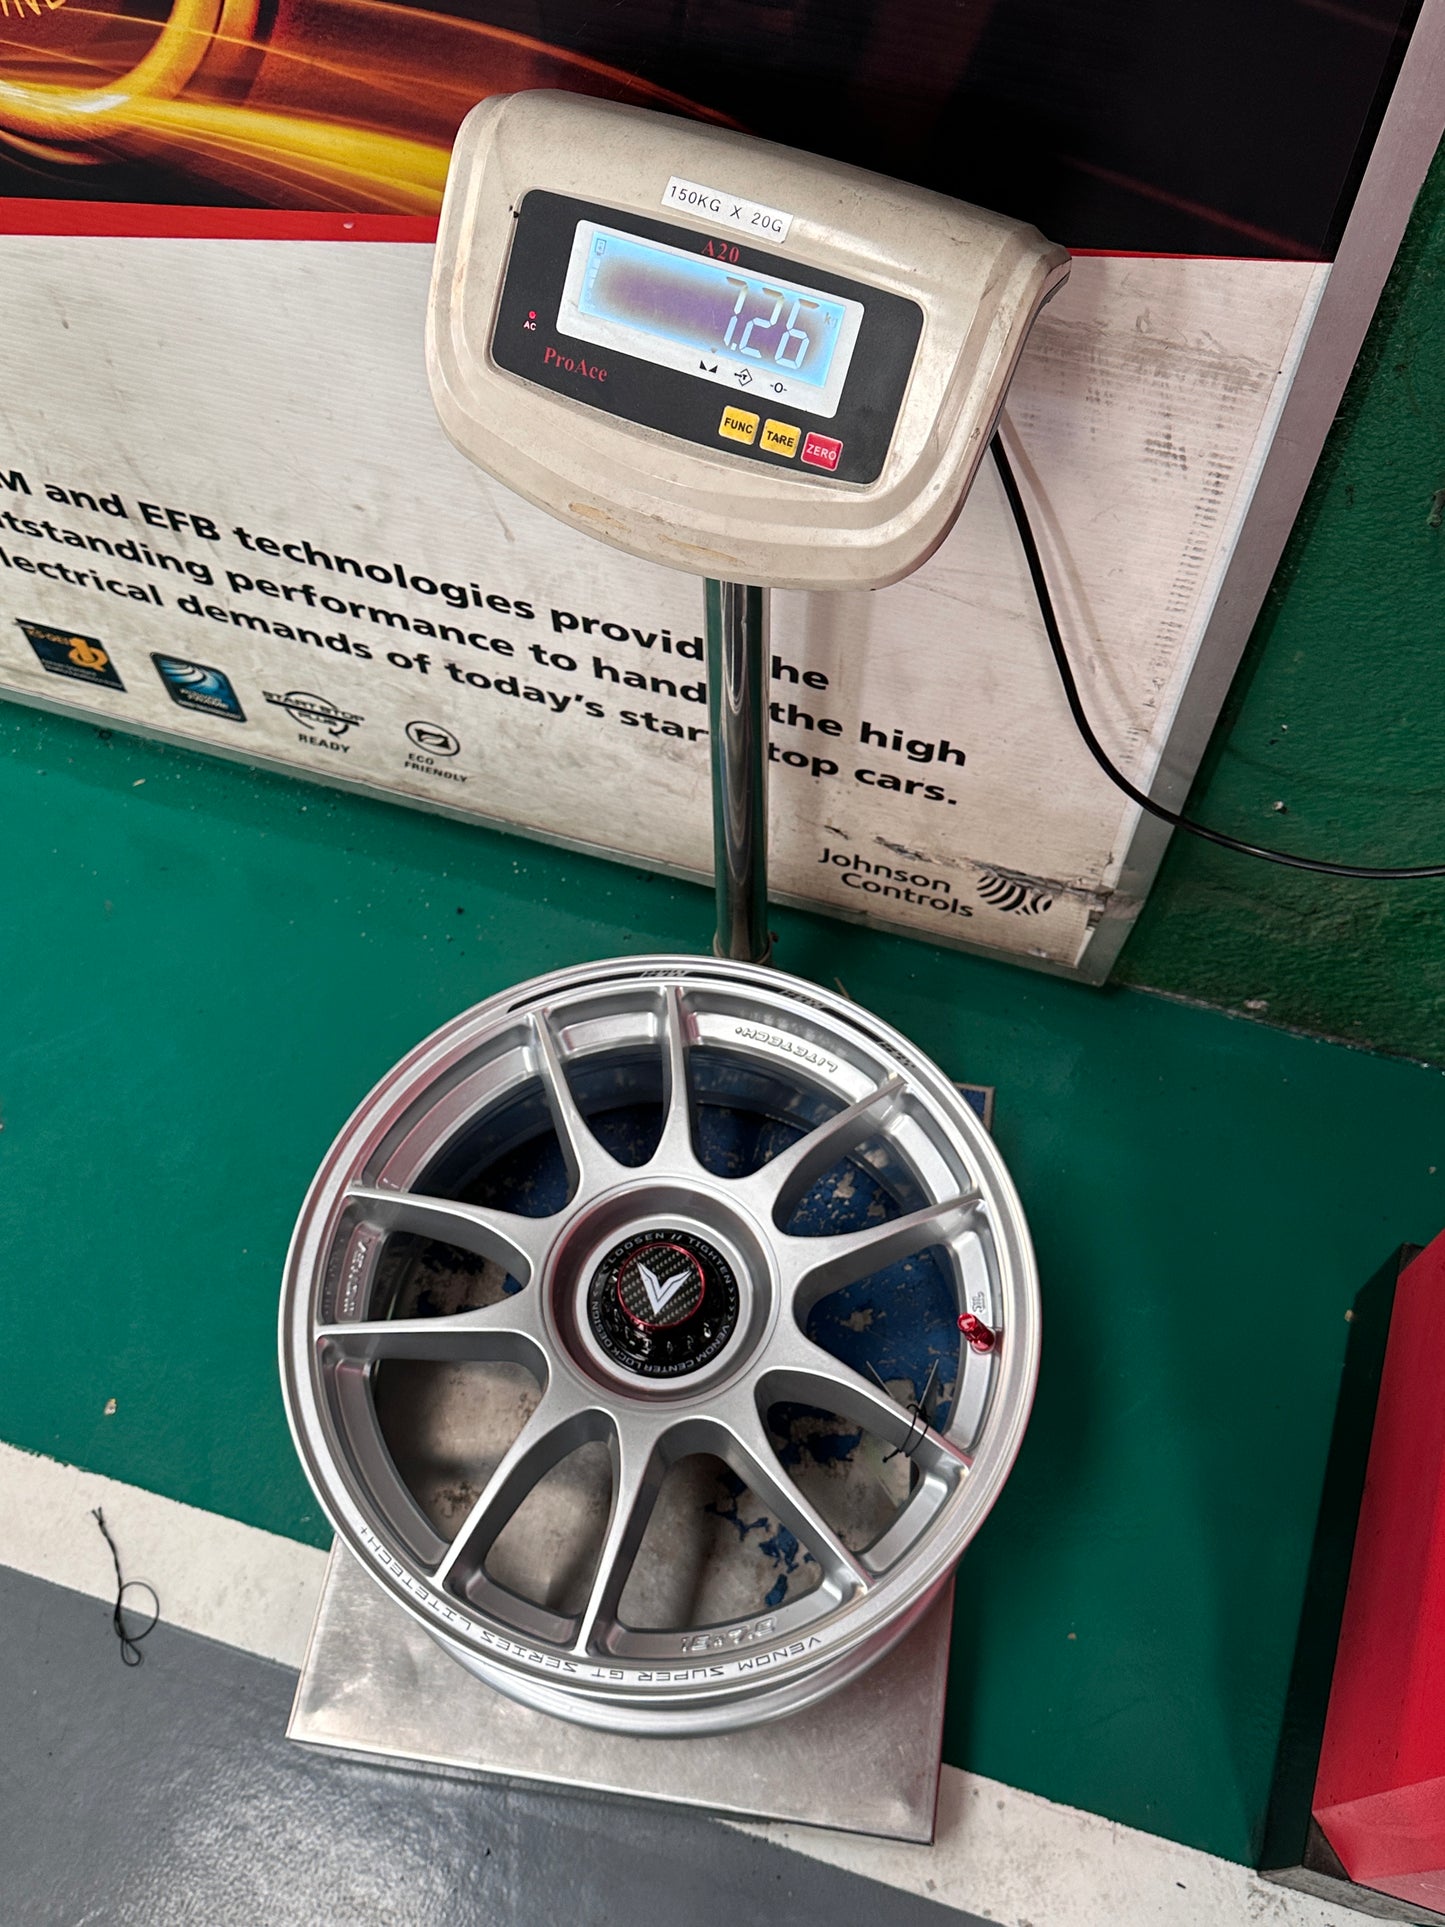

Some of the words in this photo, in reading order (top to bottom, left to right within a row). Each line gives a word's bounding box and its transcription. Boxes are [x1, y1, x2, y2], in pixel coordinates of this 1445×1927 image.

[671, 186, 721, 212] 150KG
[730, 205, 742, 219] X
[751, 212, 783, 232] 20G
[701, 240, 740, 263] A20
[523, 320, 536, 331] AC
[724, 276, 820, 370] 7.26
[543, 346, 608, 382] ProAce
[724, 417, 753, 434] FUNC
[767, 430, 795, 447] TARE
[806, 444, 837, 460] ZERO
[0, 470, 32, 495] M
[44, 493, 129, 519] and
[137, 501, 221, 541] EFB
[232, 527, 535, 619] technologies
[550, 608, 704, 661] provid
[771, 655, 829, 690] he
[0, 511, 214, 586] tstanding
[225, 570, 514, 656] performance
[528, 644, 577, 672] to
[592, 656, 707, 704] hand
[768, 702, 843, 736] the
[860, 721, 966, 766] high
[0, 546, 164, 606] lectrical
[177, 595, 373, 659] demands
[386, 653, 431, 674] of
[444, 662, 605, 718] today's
[620, 709, 708, 742] star
[768, 742, 839, 777] top
[854, 769, 957, 805] cars.
[298, 734, 350, 753] READY
[404, 761, 468, 783] FRIENDLY
[408, 753, 434, 765] ECO
[818, 847, 950, 894] Johnson
[841, 872, 974, 917] Controls
[608, 1232, 664, 1263] LOOSEN
[689, 1238, 732, 1284] TIGHTEN
[696, 1325, 730, 1362] VENOM
[611, 1348, 641, 1369] LOCK
[644, 1360, 695, 1373] CENTER
[480, 1630, 578, 1673] SERIES
[738, 1637, 822, 1671] VENOM
[592, 1667, 624, 1680] GT
[638, 1666, 725, 1682] SUPER
